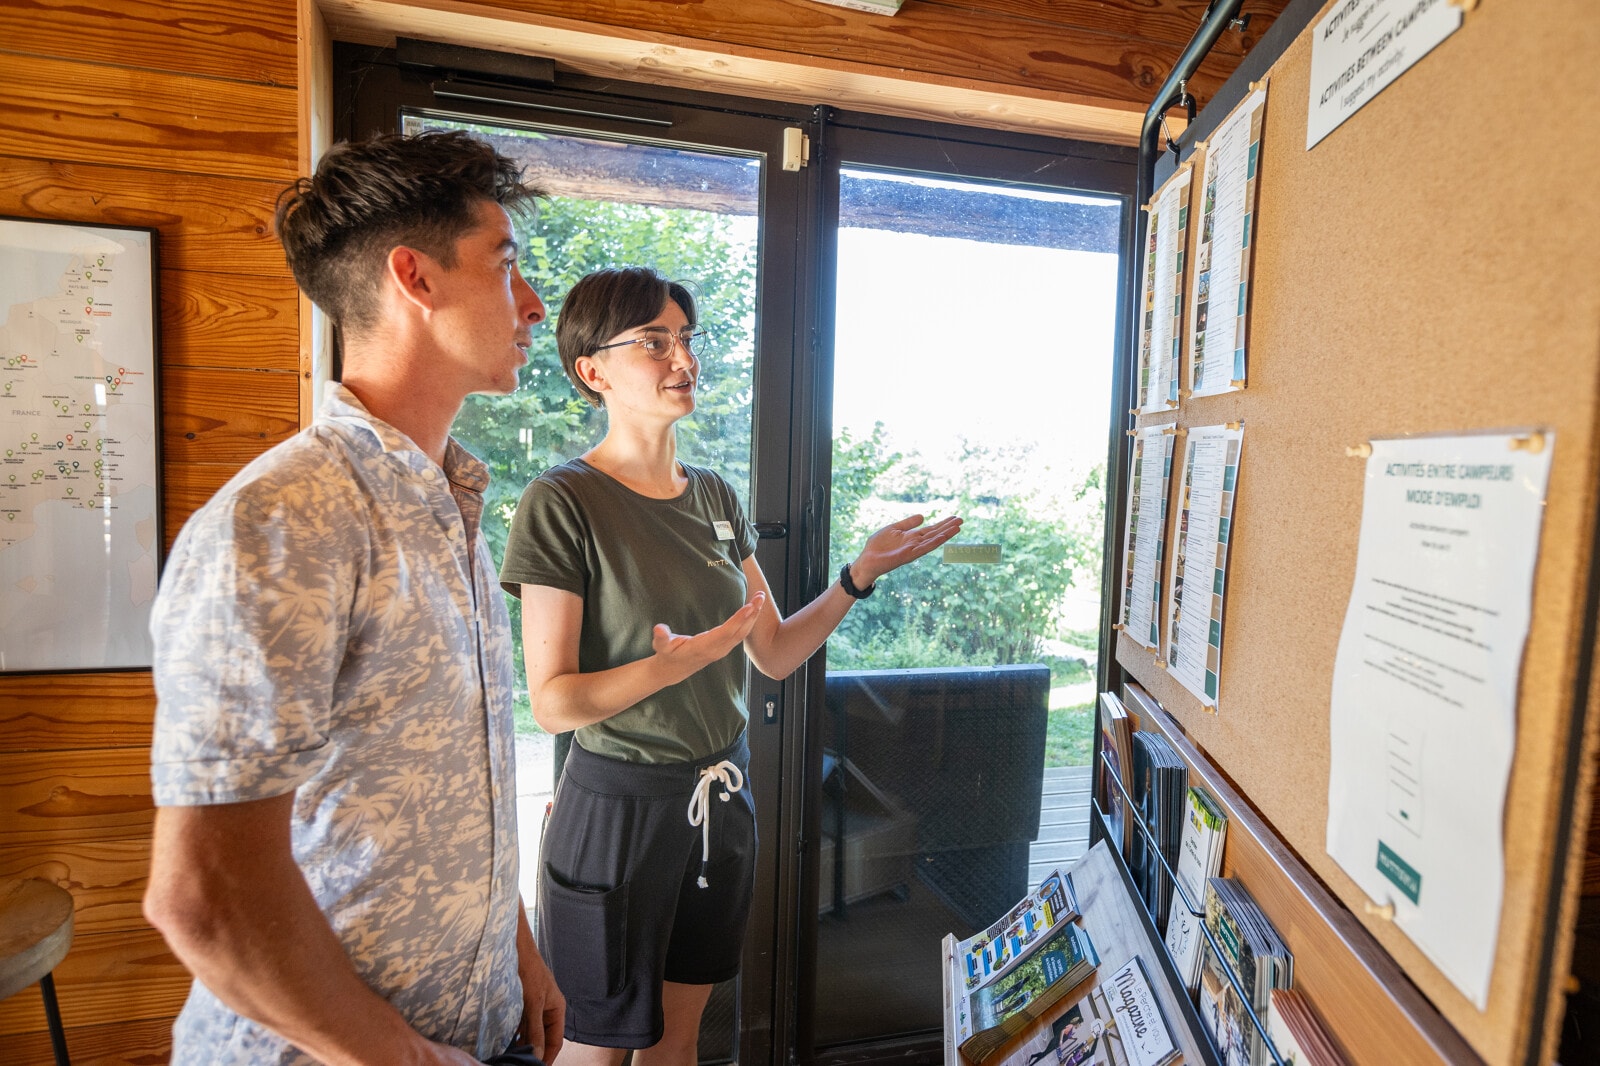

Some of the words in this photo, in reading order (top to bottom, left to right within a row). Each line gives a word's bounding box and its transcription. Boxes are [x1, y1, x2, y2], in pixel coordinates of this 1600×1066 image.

[1319, 63, 1356, 107] ACTIVITIES
[1357, 27, 1393, 74] BETWEEN
[12, 409, 41, 417] FRANCE
[1427, 463, 1456, 479] ENTRE
[1459, 464, 1514, 481] CAMPEURS
[1406, 489, 1433, 504] MODE
[1115, 968, 1148, 1039] Magazine
[1140, 992, 1153, 1020] Perche
